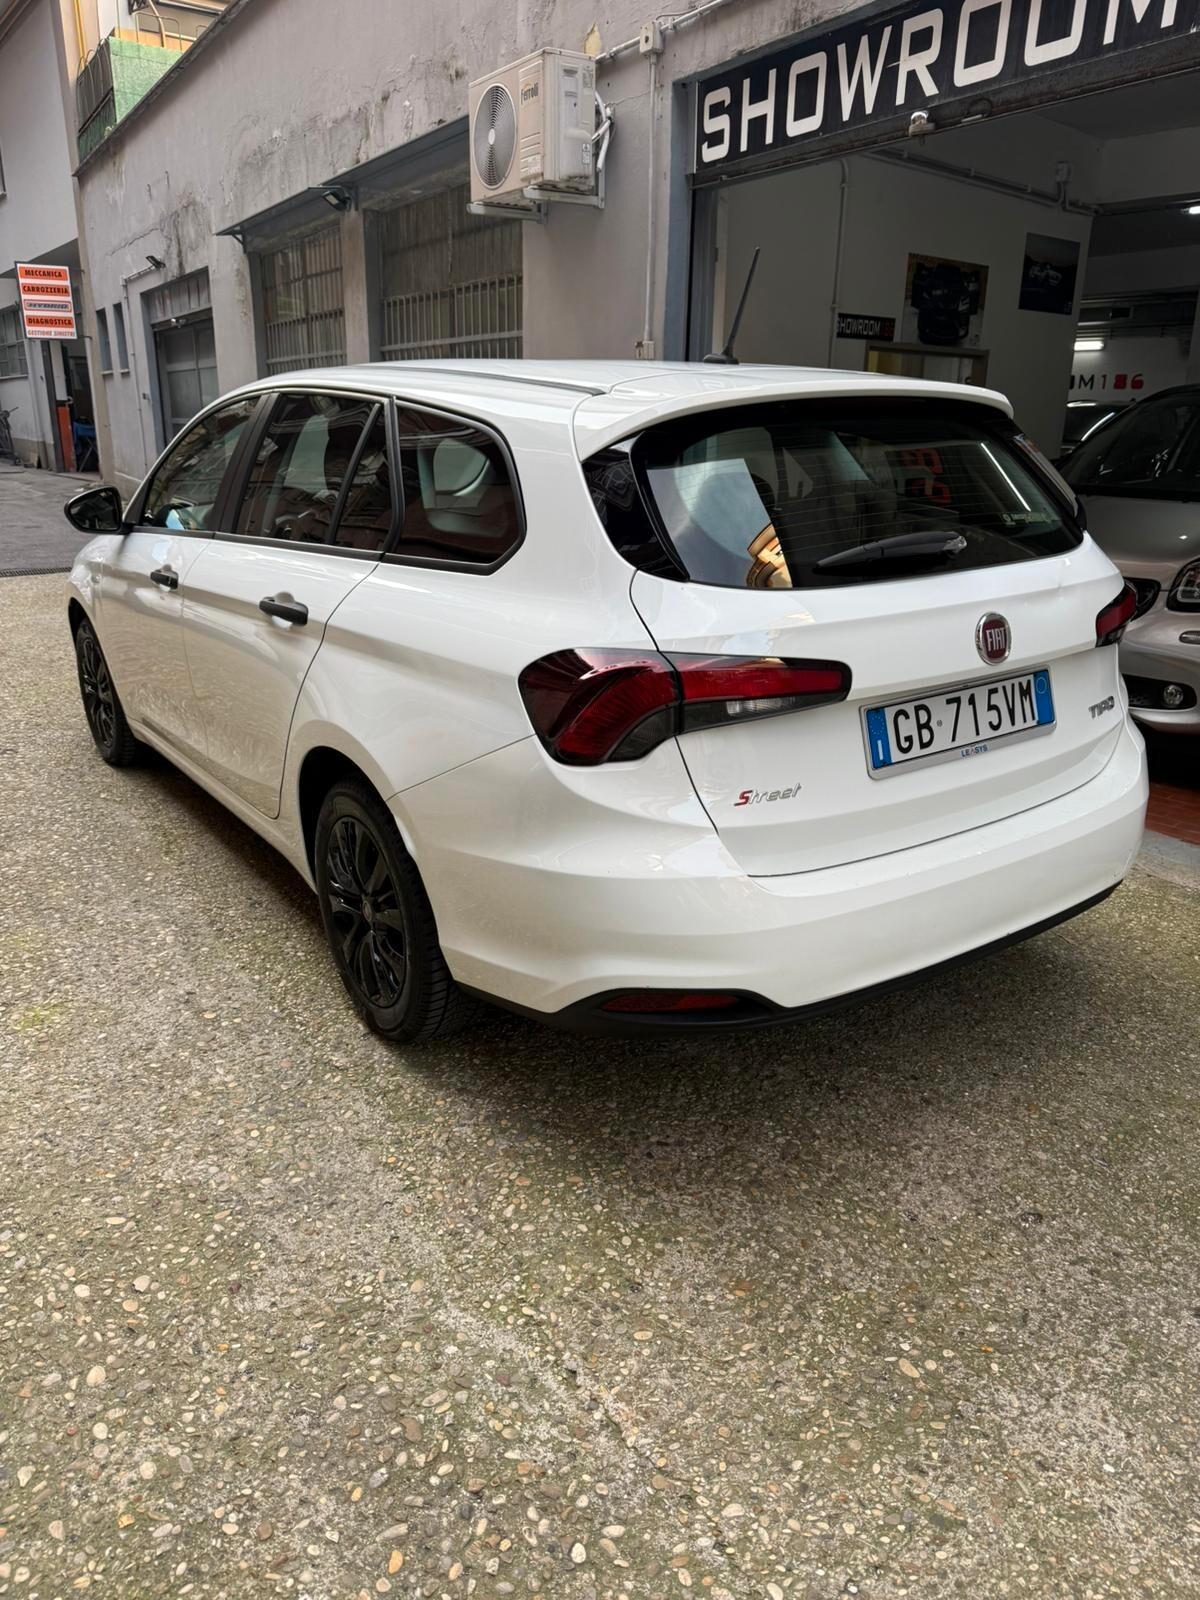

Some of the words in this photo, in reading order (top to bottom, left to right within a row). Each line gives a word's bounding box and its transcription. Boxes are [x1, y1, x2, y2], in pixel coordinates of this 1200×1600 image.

[520, 82, 539, 106] Ferroli
[24, 269, 62, 278] MECCANICA
[22, 285, 69, 295] CARROZZERIA
[28, 317, 72, 326] DIAGNOSTICA
[985, 626, 1007, 653] FIAT
[893, 703, 935, 755] GB
[945, 678, 1036, 743] 715VM
[1088, 695, 1115, 719] TIPO
[733, 782, 802, 807] Street
